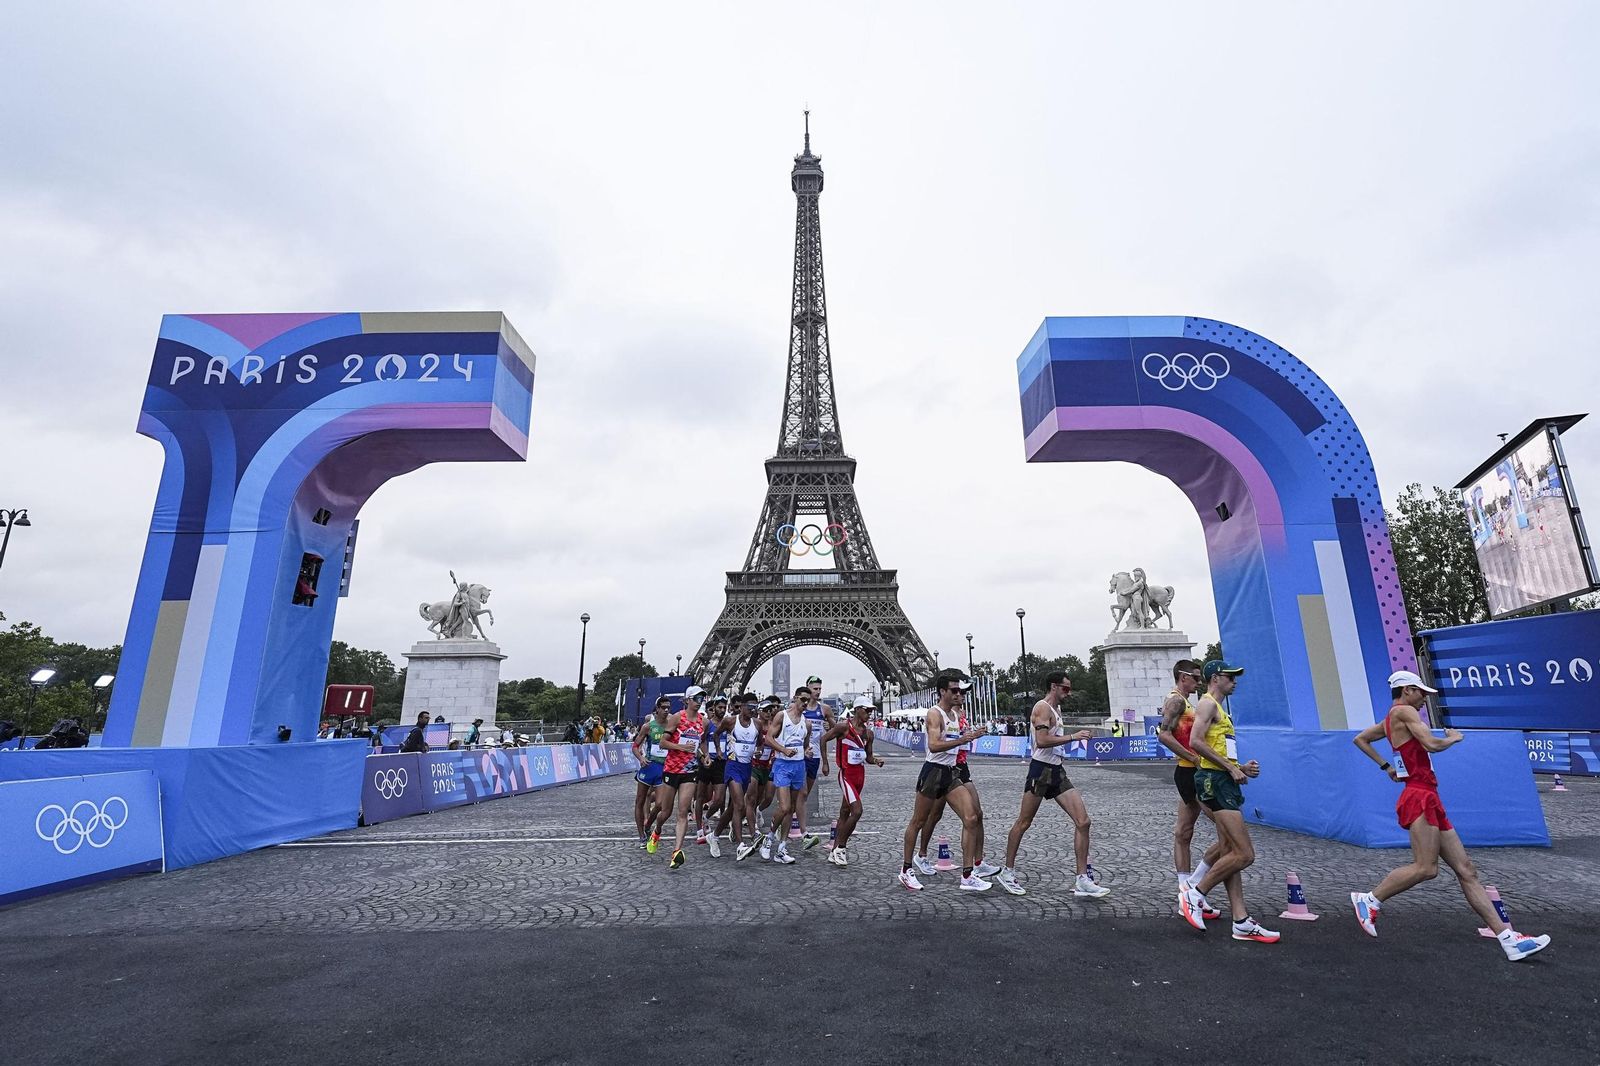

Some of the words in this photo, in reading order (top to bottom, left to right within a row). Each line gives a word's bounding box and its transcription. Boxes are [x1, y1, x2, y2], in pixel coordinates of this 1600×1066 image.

[340, 353, 474, 383] 2024
[1545, 657, 1600, 685] 20
[344, 690, 368, 709] 11
[1528, 751, 1554, 762] 024
[433, 778, 457, 794] 2024
